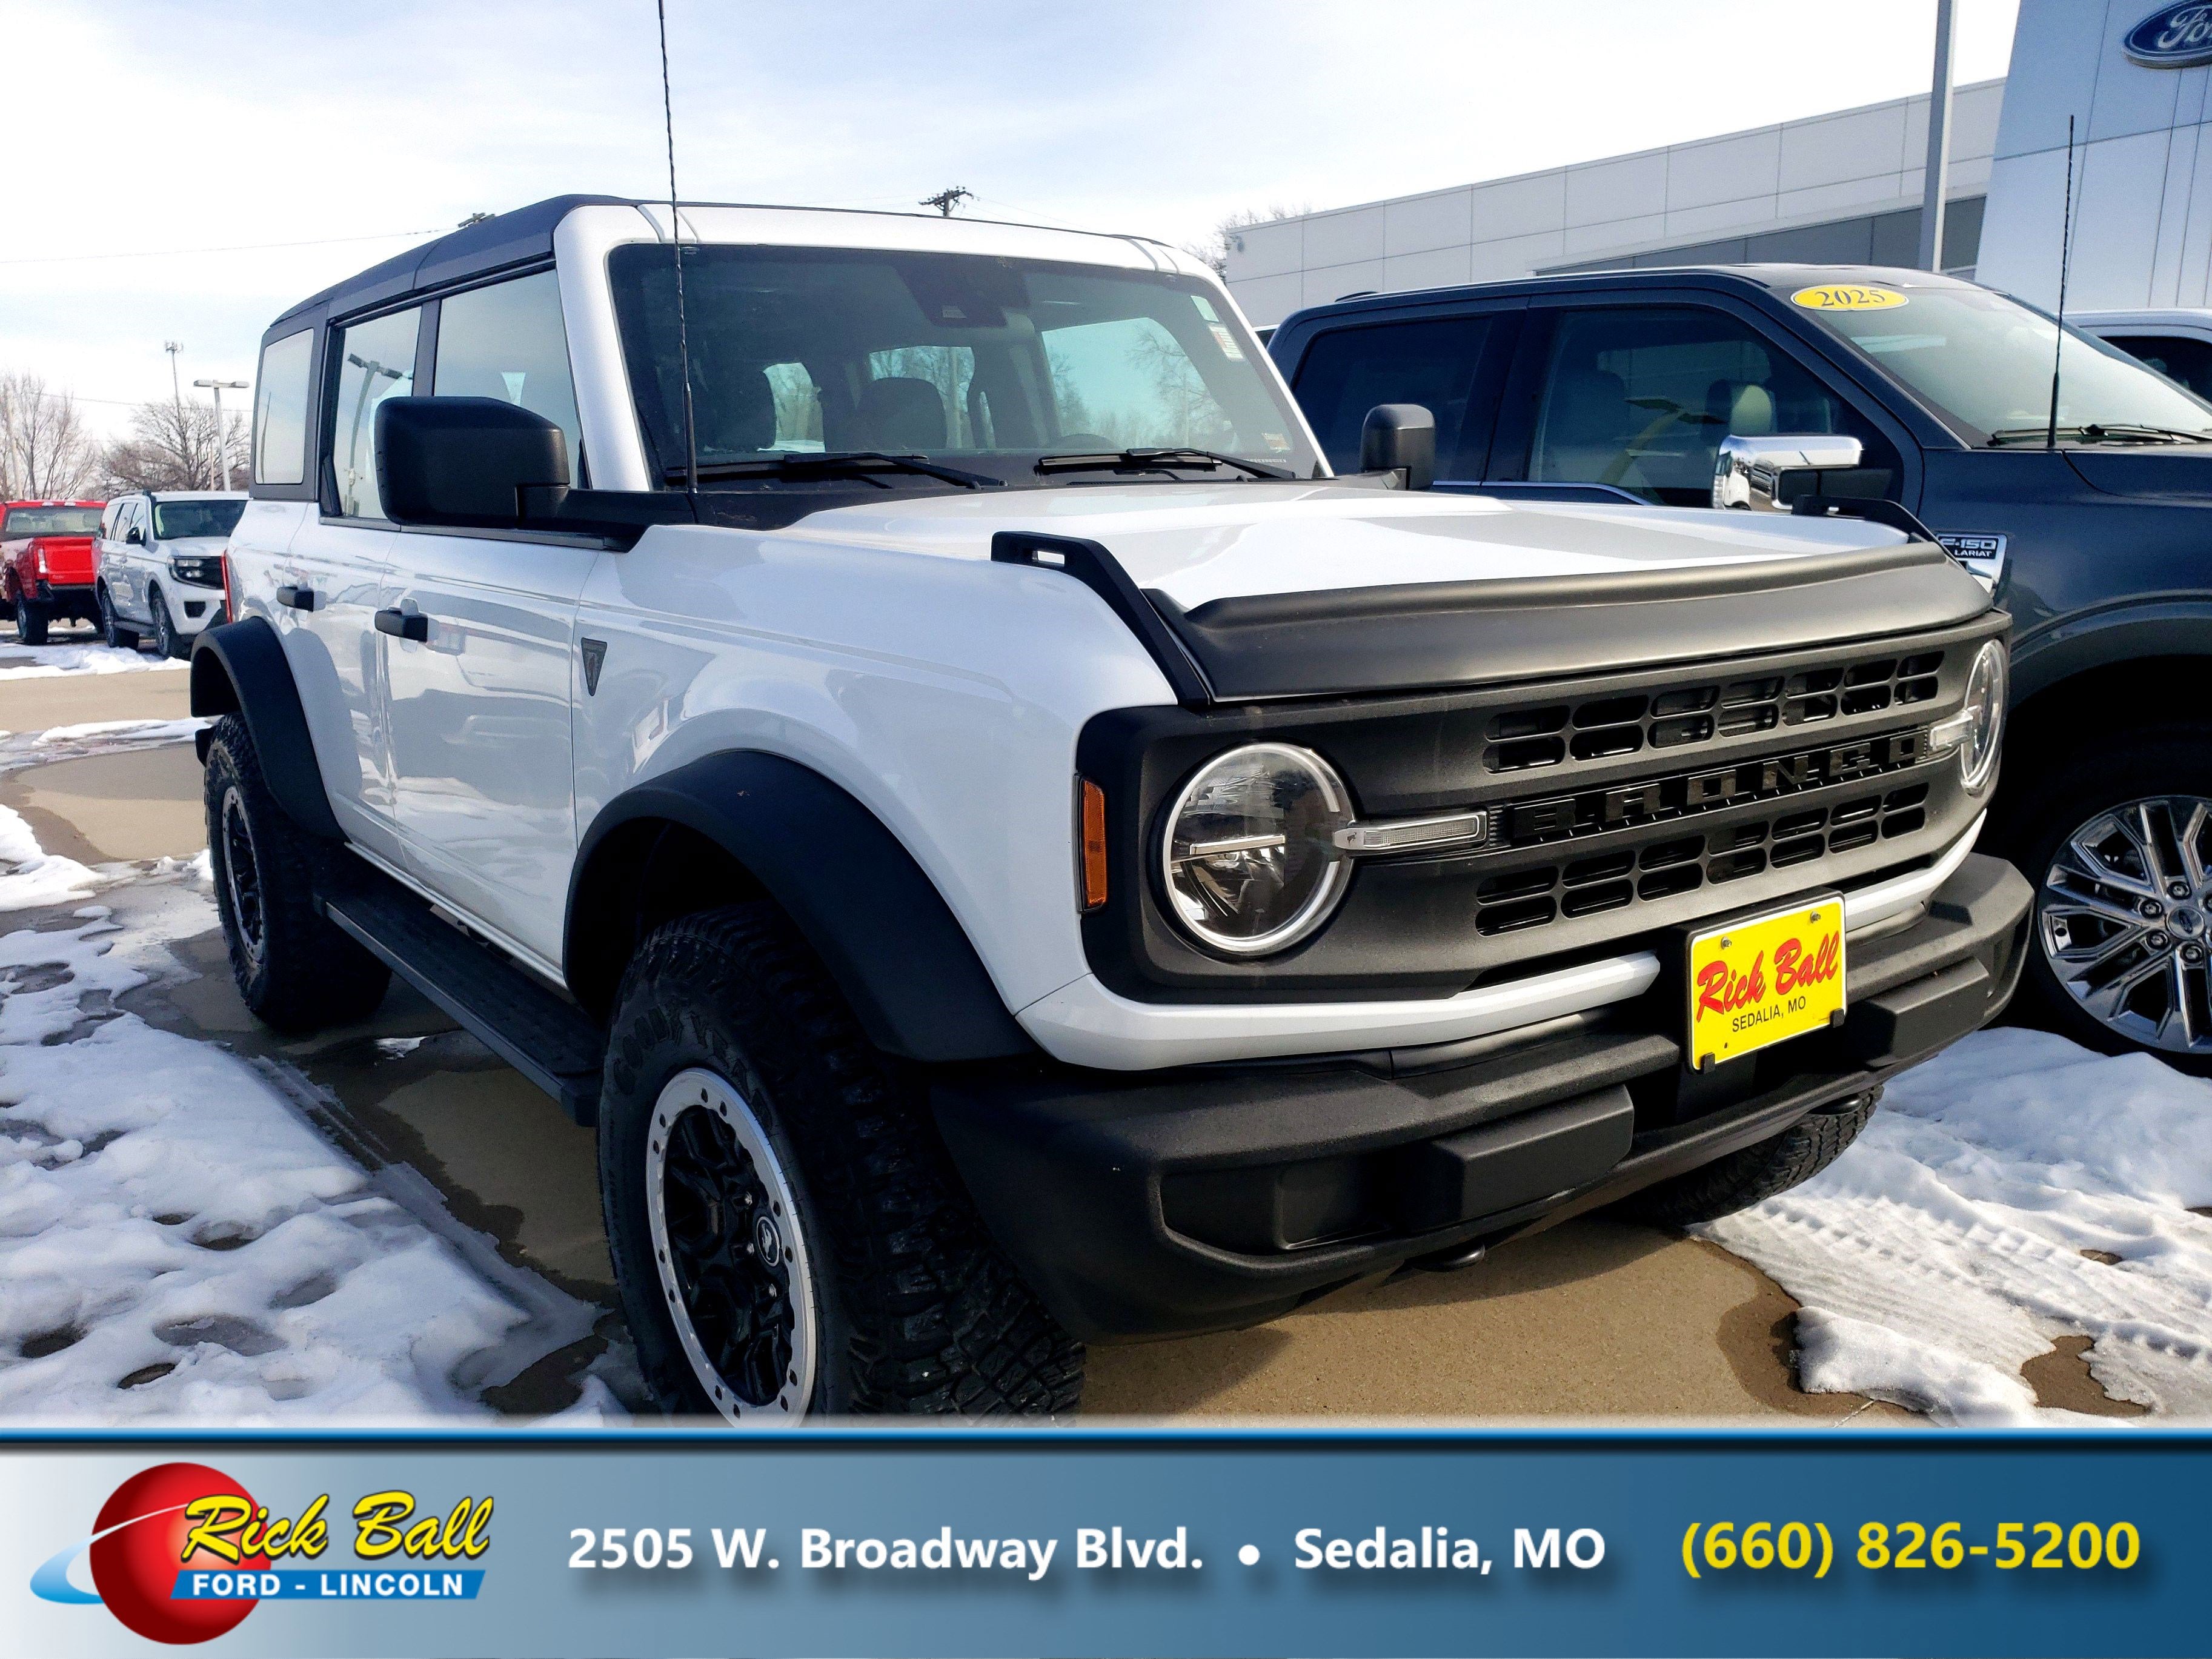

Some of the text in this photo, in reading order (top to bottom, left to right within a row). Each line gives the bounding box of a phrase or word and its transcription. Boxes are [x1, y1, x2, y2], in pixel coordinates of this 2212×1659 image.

[1815, 289, 1885, 307] 2025
[1513, 734, 1924, 839] BRONCO
[1696, 930, 1839, 1023] Rick Ball
[1732, 996, 1806, 1032] SEDALIA, MO
